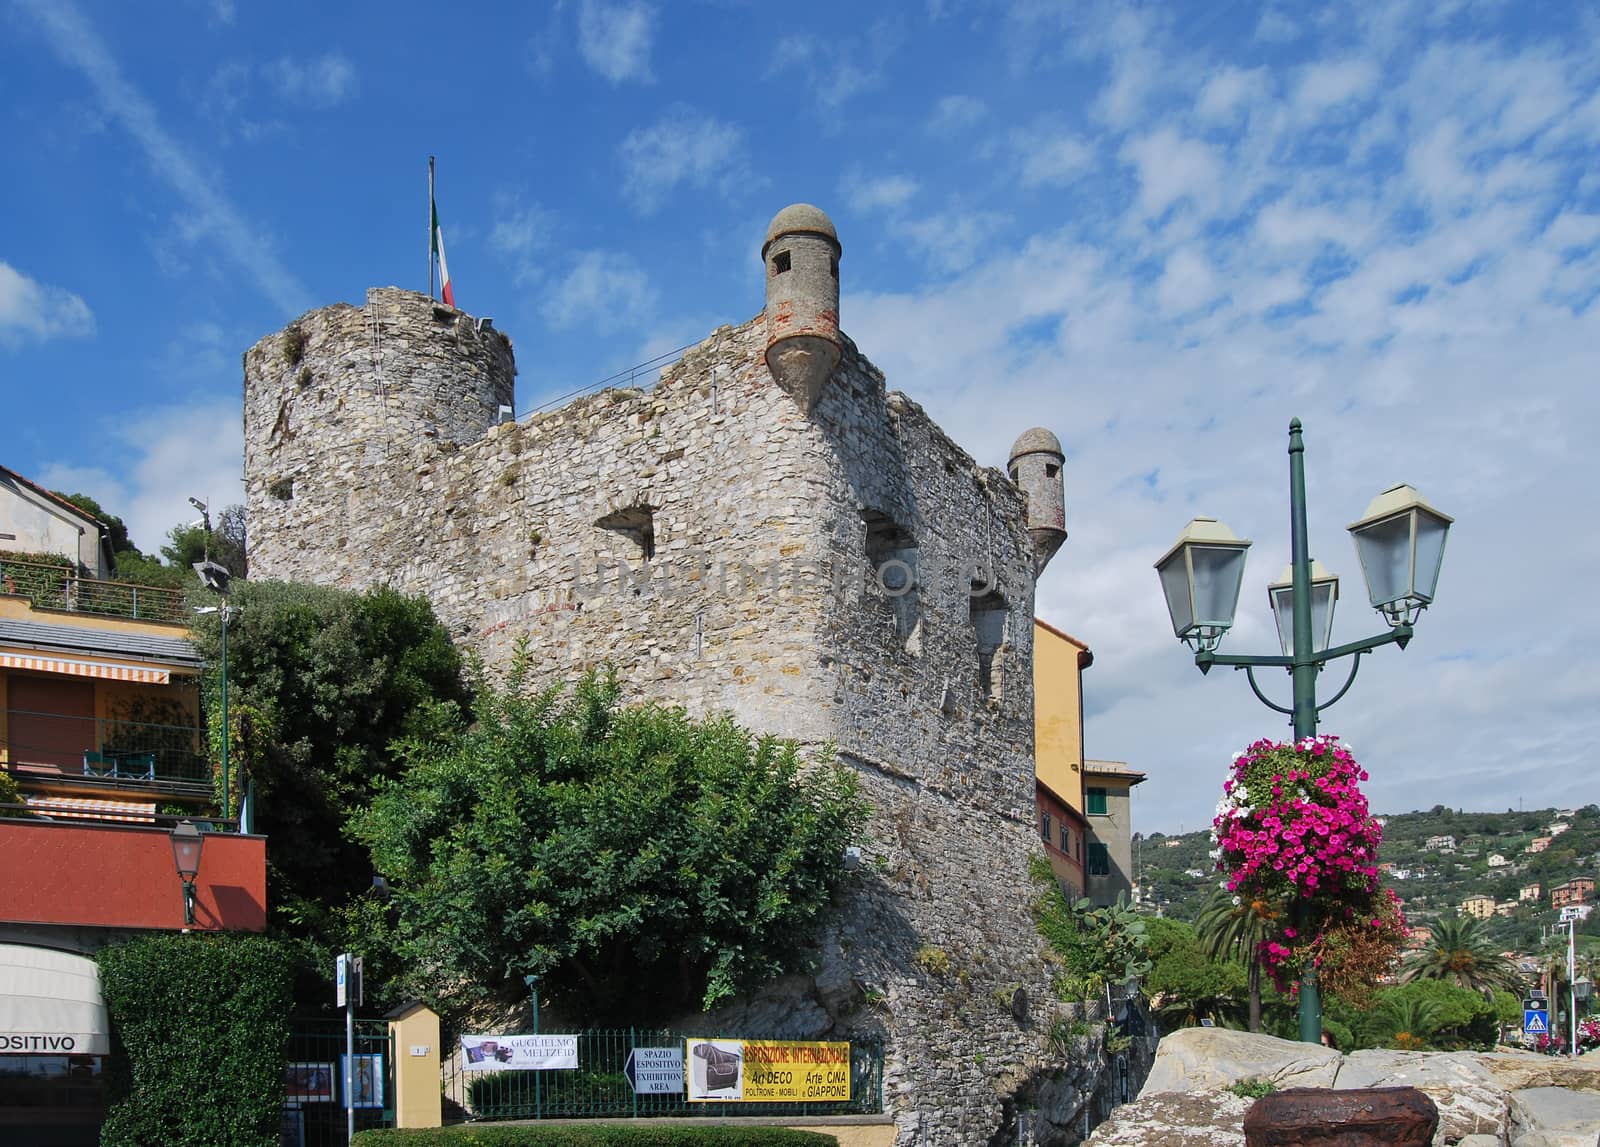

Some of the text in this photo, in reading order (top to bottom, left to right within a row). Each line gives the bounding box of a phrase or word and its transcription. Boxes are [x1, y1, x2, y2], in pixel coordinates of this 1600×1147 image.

[0, 1036, 75, 1050] OSITIVO
[644, 1050, 672, 1058] SPAZIO
[744, 1046, 848, 1063] ESPOSIZIONE INTERNAZIONALE
[636, 1060, 681, 1069] ESPOSITIVO
[636, 1072, 681, 1081] EXHIBITION
[751, 1071, 793, 1084] Art DECO
[805, 1071, 846, 1084] Arte CINA
[649, 1083, 670, 1091] AREA
[745, 1088, 775, 1096] POLTRONE
[779, 1087, 798, 1096] MOBILI
[807, 1085, 847, 1097] GIAPPONE
